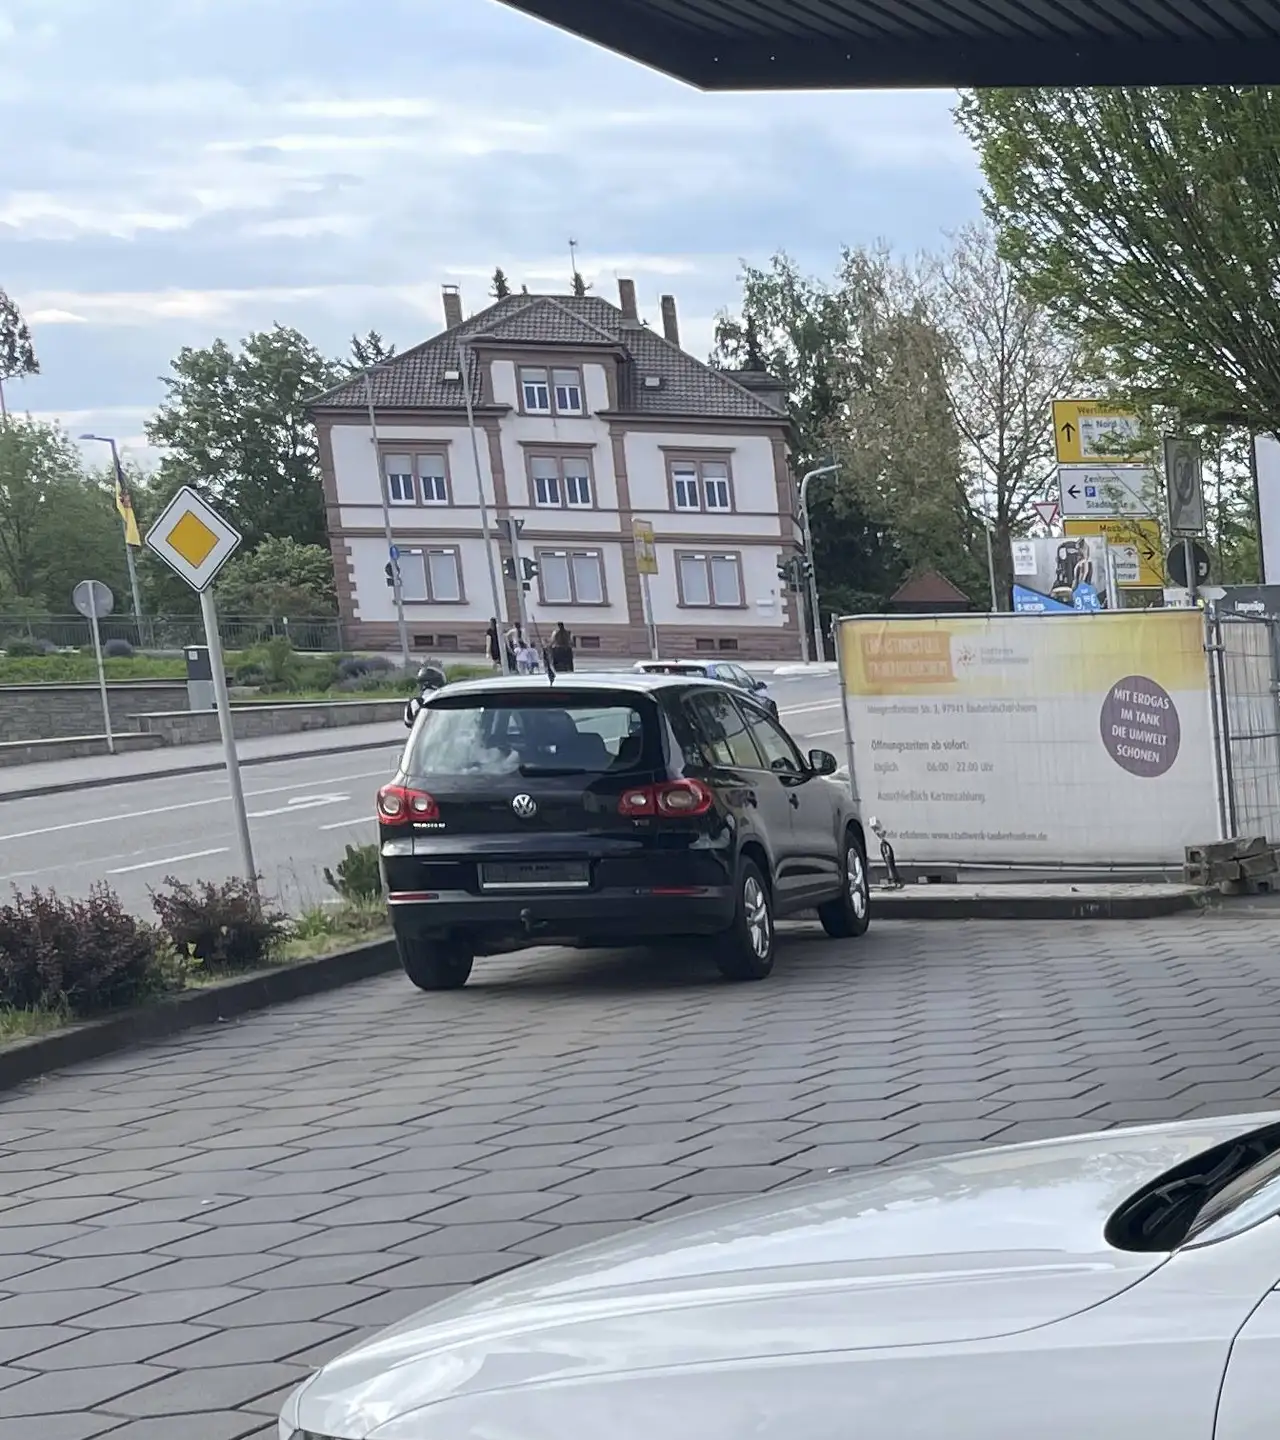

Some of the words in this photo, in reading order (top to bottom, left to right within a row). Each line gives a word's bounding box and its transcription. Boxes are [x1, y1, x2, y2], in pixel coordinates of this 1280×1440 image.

[1113, 688, 1130, 703] MIT
[1132, 691, 1170, 710] ERDGAS
[1120, 707, 1133, 722] IM
[1135, 710, 1160, 727] TANK
[931, 739, 942, 750] ab
[1111, 724, 1128, 739] DIE
[1128, 728, 1167, 746] UMWELT
[1116, 743, 1161, 763] SCHONEN
